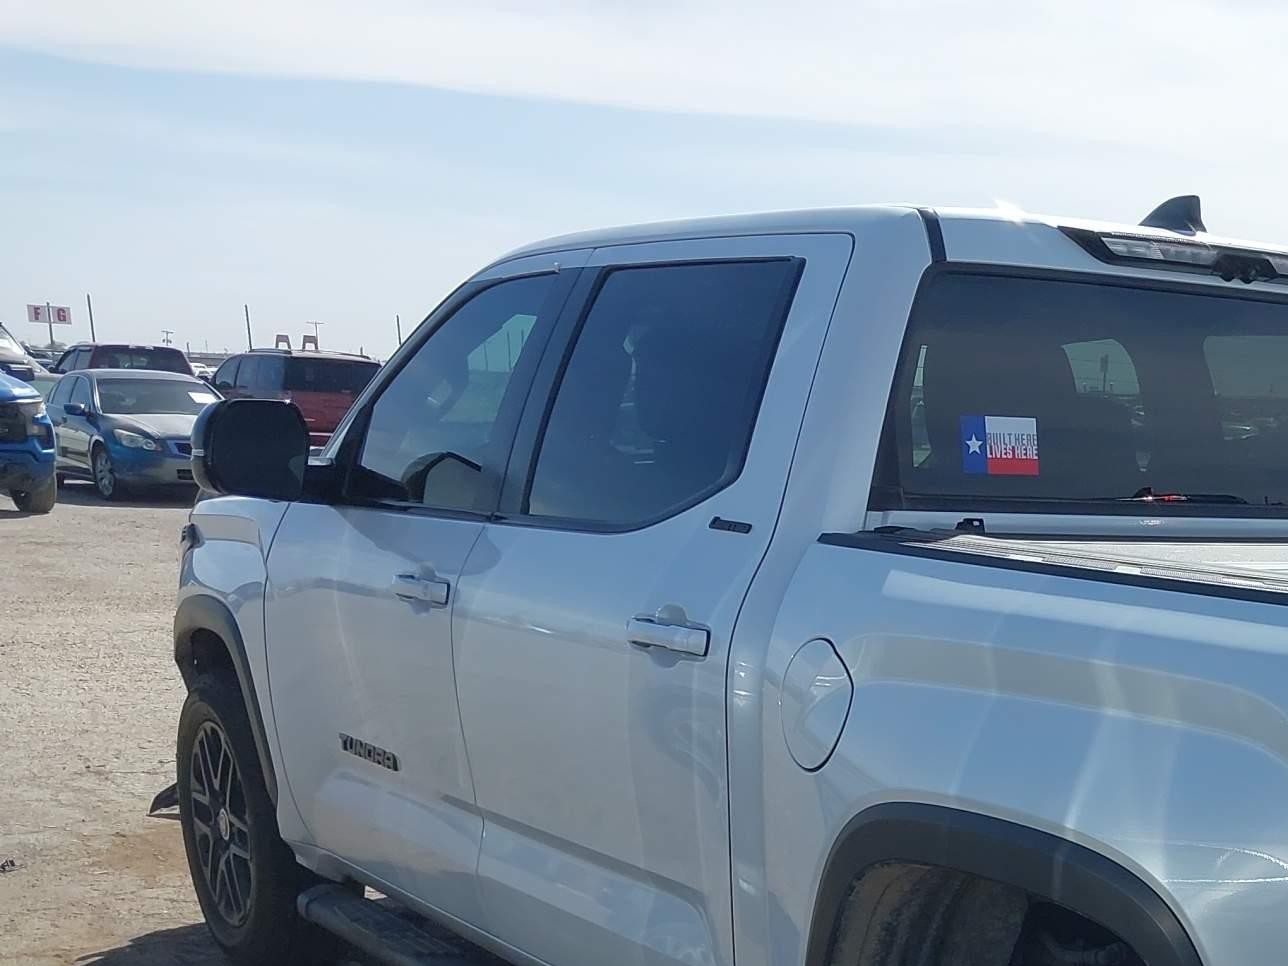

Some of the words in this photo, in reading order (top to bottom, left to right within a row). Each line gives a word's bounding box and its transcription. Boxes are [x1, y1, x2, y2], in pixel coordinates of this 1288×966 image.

[33, 307, 41, 321] F
[56, 307, 67, 322] G
[986, 432, 1013, 447] BUILT
[1014, 432, 1038, 447] HERE
[986, 445, 1013, 459] LIVES
[1014, 446, 1039, 460] HERE
[339, 732, 400, 772] TUNDRA
